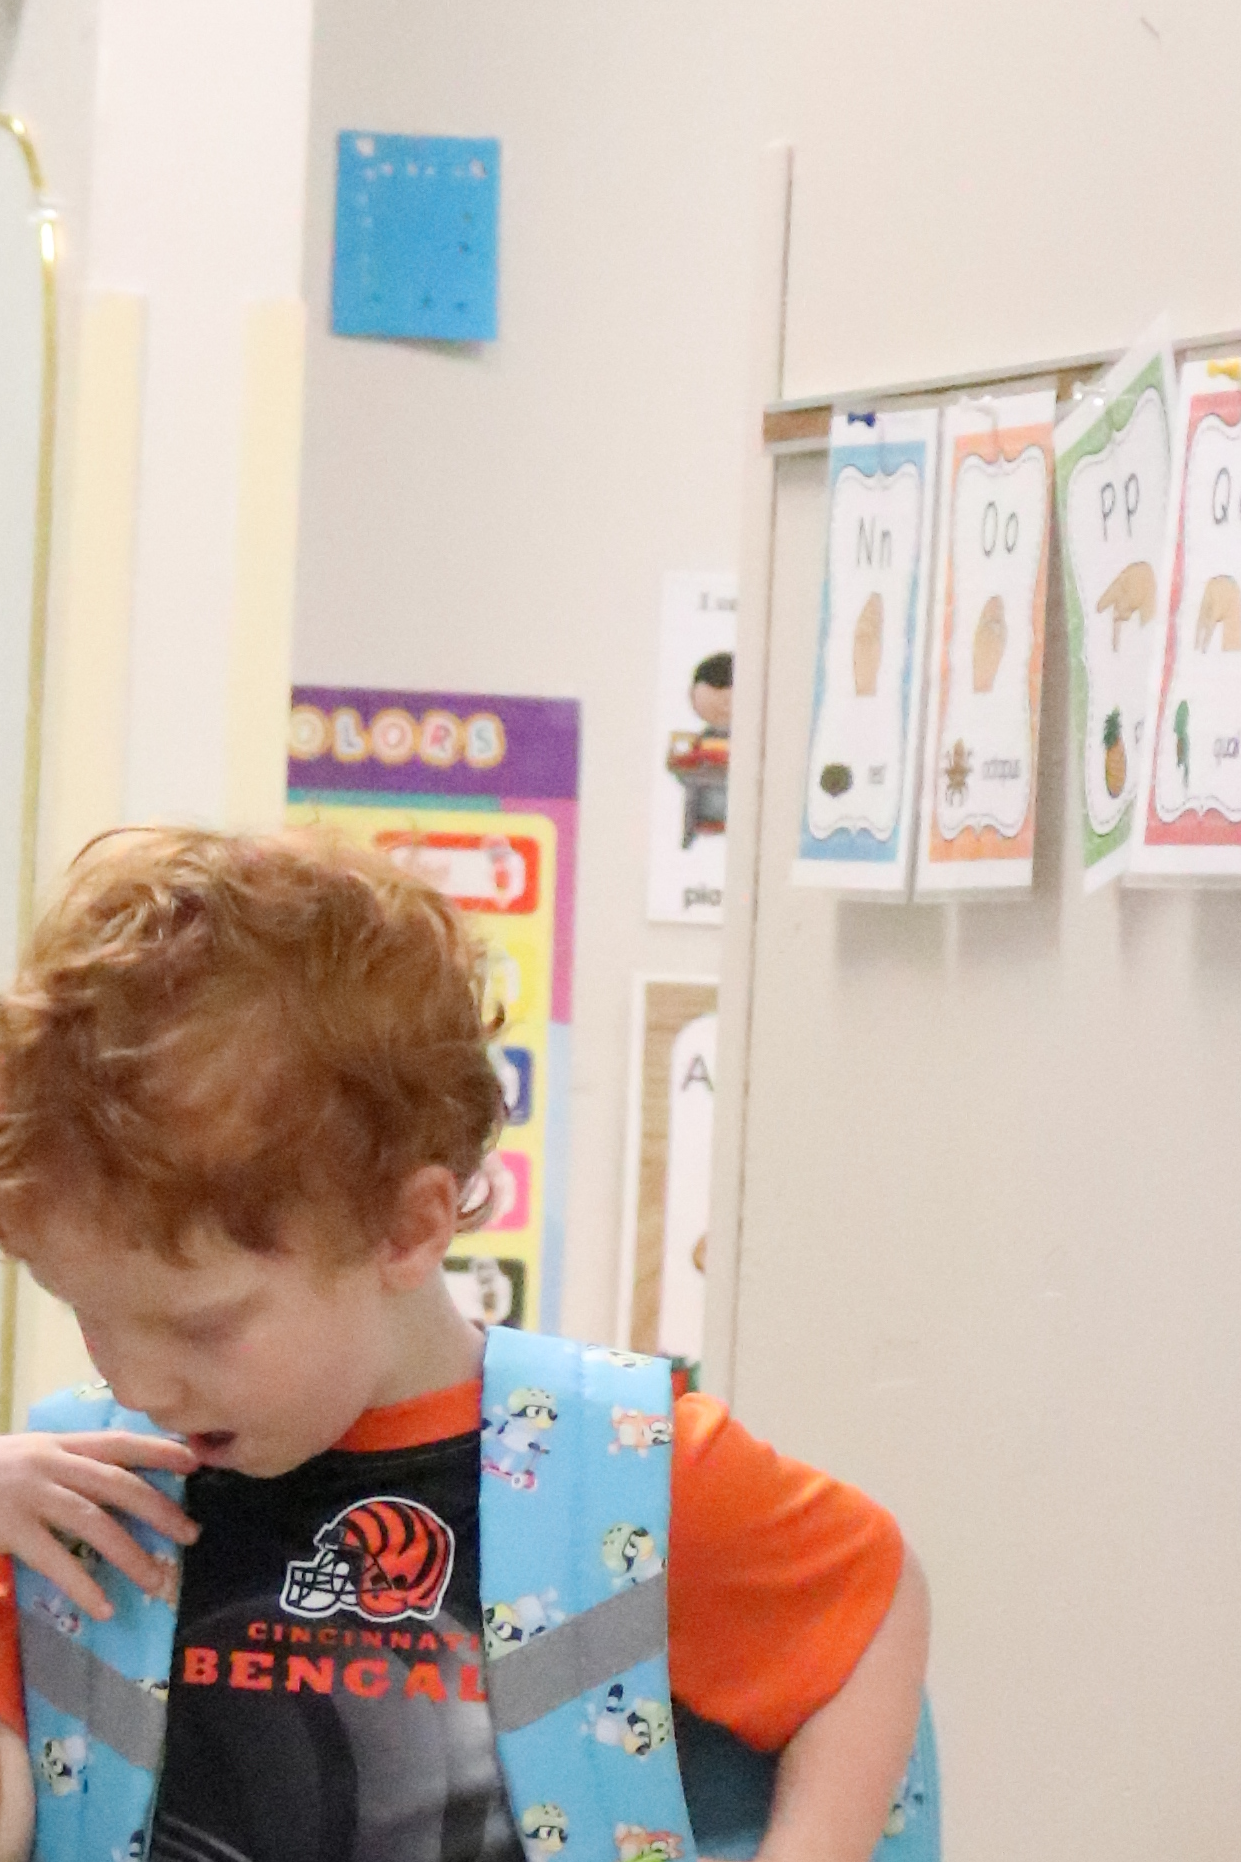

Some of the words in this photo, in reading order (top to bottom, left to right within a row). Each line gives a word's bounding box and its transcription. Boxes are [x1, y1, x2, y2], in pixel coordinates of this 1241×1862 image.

[1212, 467, 1239, 526] Q
[981, 500, 1019, 558] Oo
[681, 1055, 714, 1093] A
[247, 1620, 479, 1653] CINCINNATI
